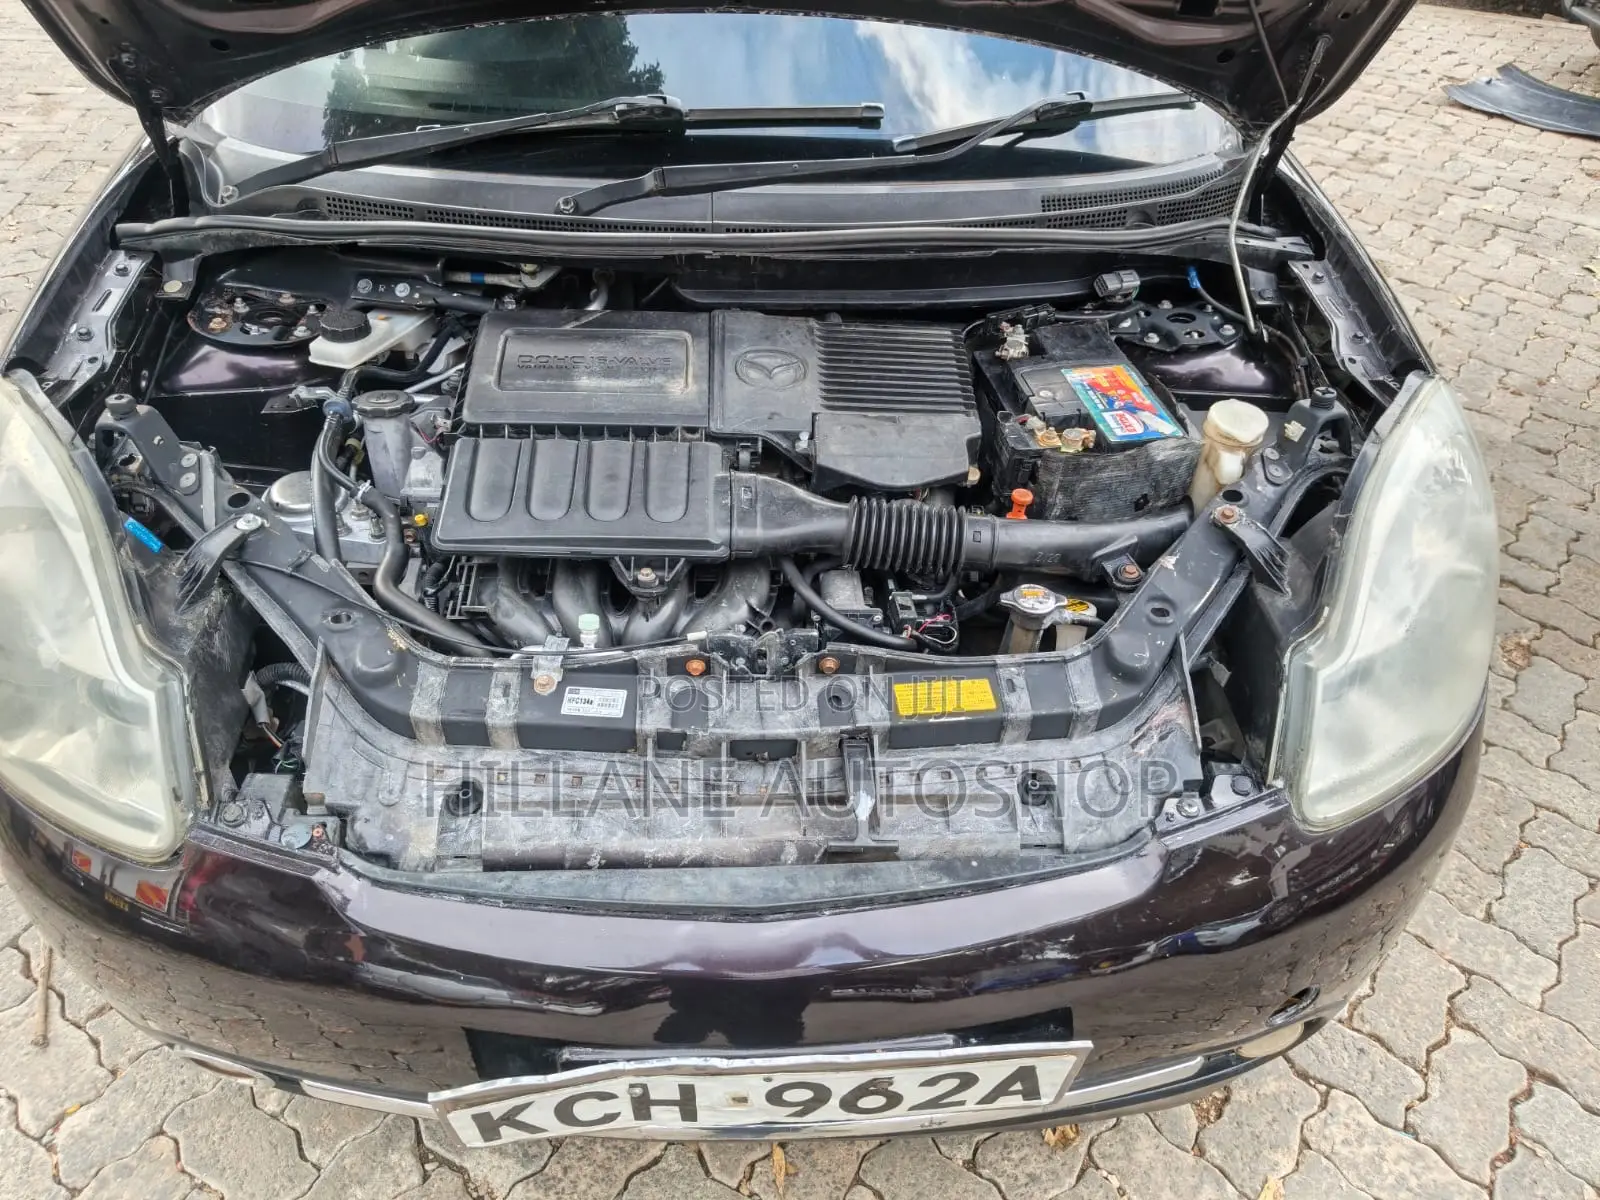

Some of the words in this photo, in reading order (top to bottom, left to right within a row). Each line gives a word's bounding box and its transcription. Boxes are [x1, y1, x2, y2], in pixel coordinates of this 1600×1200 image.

[517, 354, 585, 365] DOHC
[471, 1083, 699, 1143] KCH
[764, 1064, 1043, 1118] 962A
